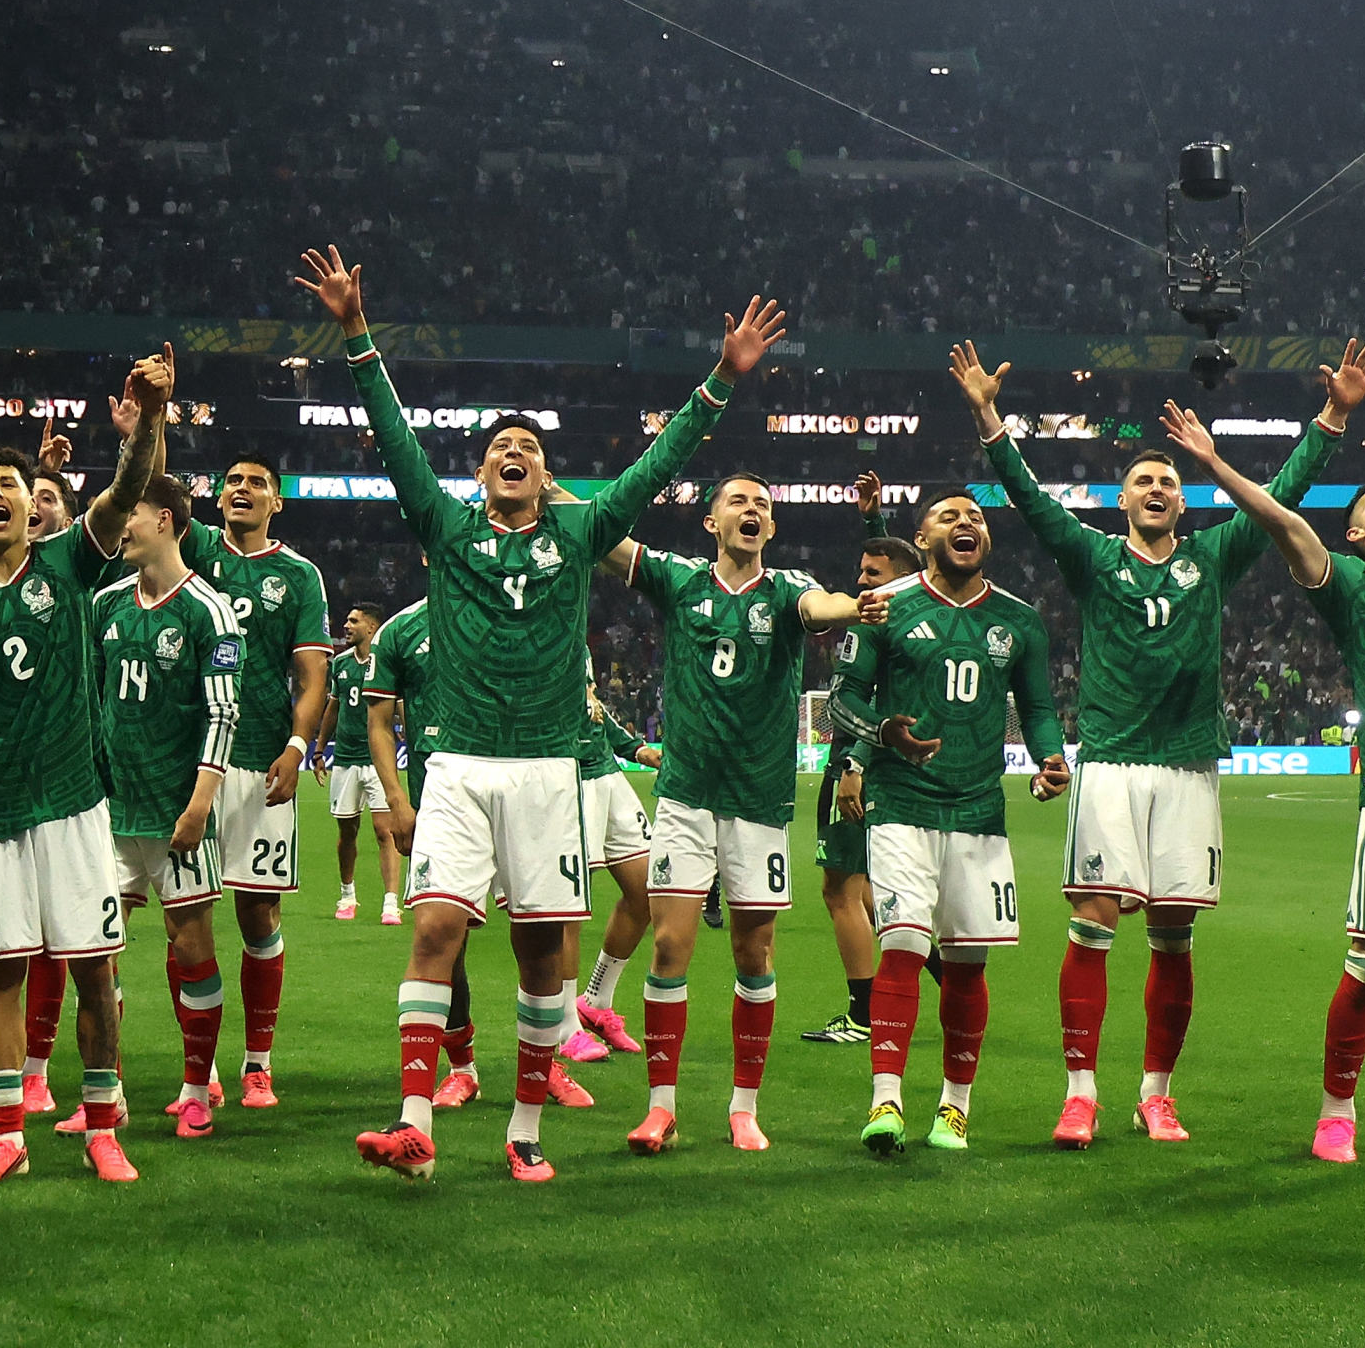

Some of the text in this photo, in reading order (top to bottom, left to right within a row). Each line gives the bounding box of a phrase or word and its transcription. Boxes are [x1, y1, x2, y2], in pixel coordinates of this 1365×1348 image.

[29, 398, 87, 419] CITY
[299, 405, 349, 426] FIFA
[349, 406, 432, 428] WLD
[432, 409, 480, 429] CUP
[767, 414, 920, 434] MEXICO CITY
[299, 477, 349, 498] FIFA
[768, 484, 921, 504] MEXICO ITY
[503, 576, 527, 610] 4
[1144, 596, 1170, 627] 11
[218, 592, 253, 635] 2
[3, 636, 35, 681] 2
[711, 638, 737, 678] 8
[119, 659, 148, 701] 14
[349, 686, 359, 707] 9
[944, 658, 978, 702] 10
[168, 850, 202, 890] 14
[252, 838, 288, 877] 22
[558, 854, 581, 897] 4
[767, 853, 785, 894] 8
[102, 895, 119, 939] 2
[991, 881, 1017, 922] 10
